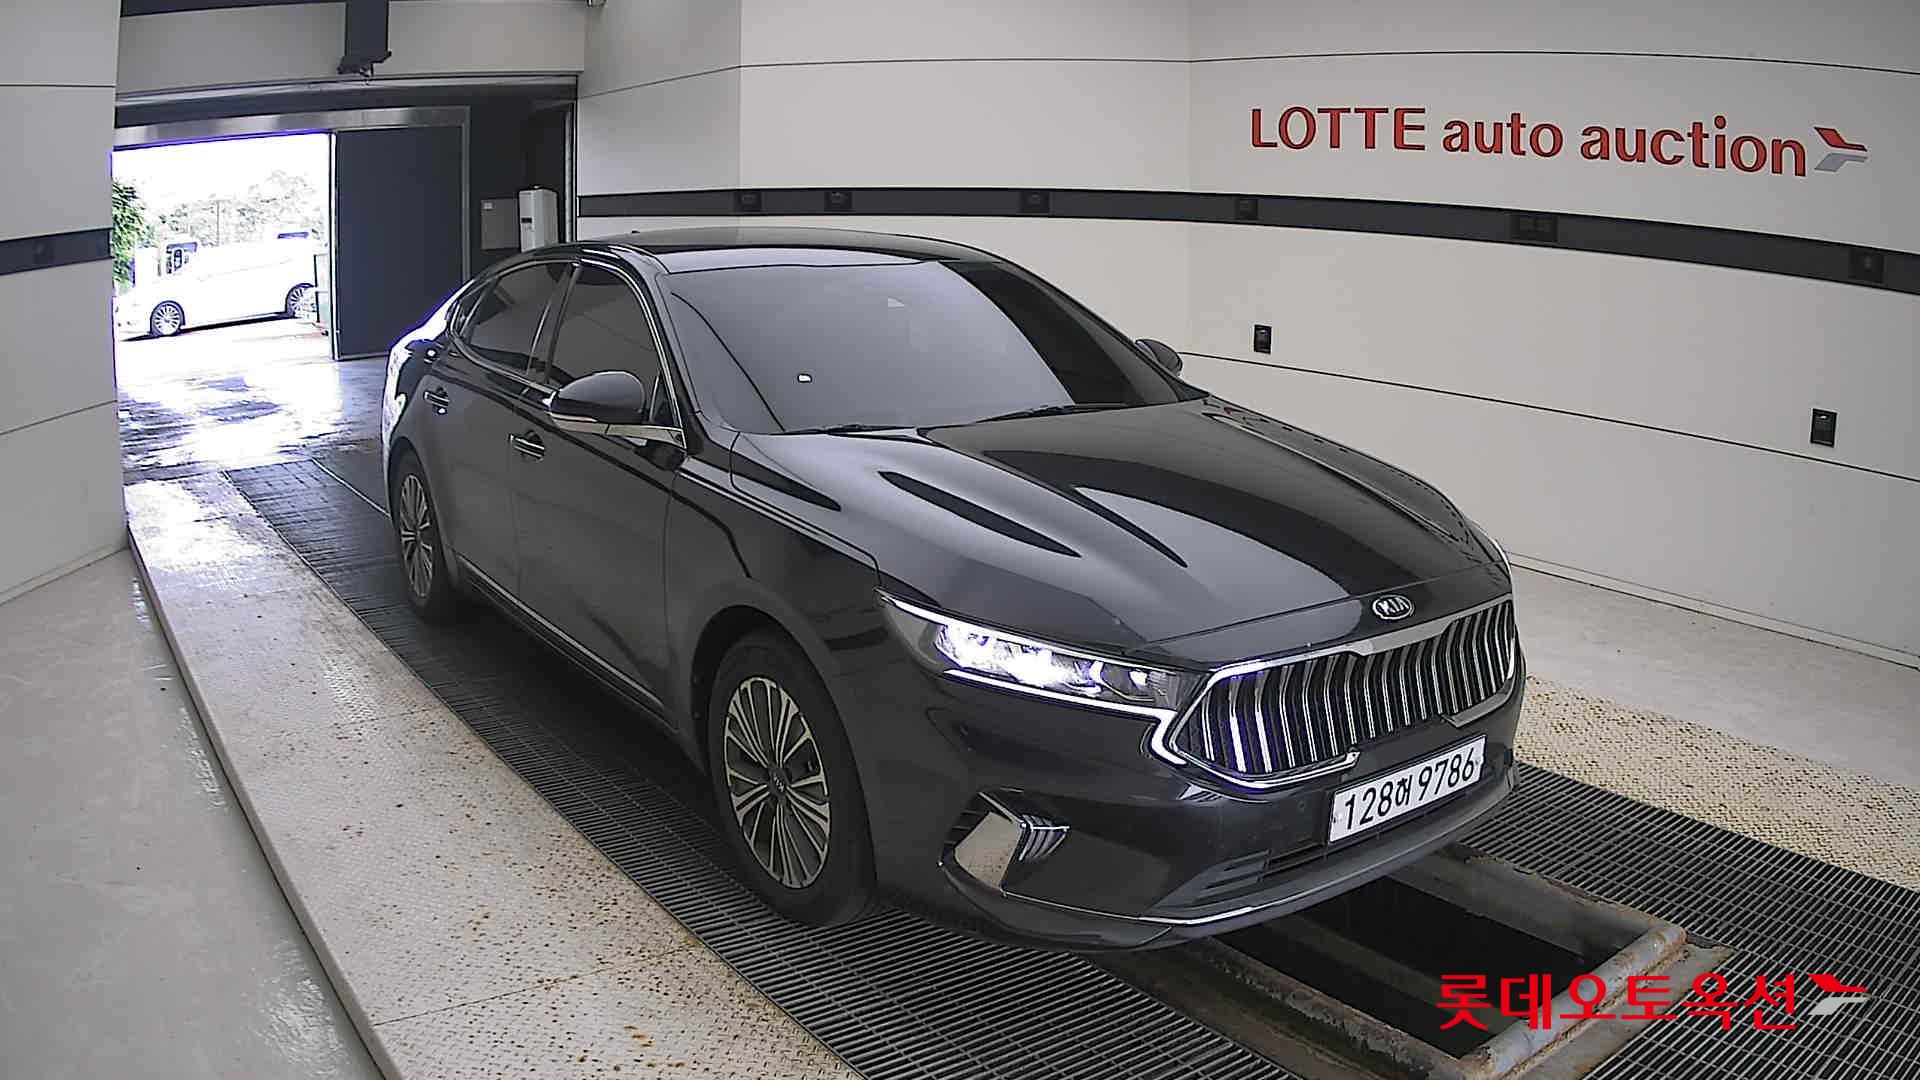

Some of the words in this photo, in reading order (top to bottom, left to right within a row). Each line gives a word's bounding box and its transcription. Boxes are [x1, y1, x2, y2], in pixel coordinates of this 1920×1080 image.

[1250, 106, 1426, 152] LOTTE
[1441, 112, 1564, 158] auto
[1579, 115, 1807, 177] auction
[1345, 774, 1413, 830] 128허
[1418, 748, 1475, 801] 9786
